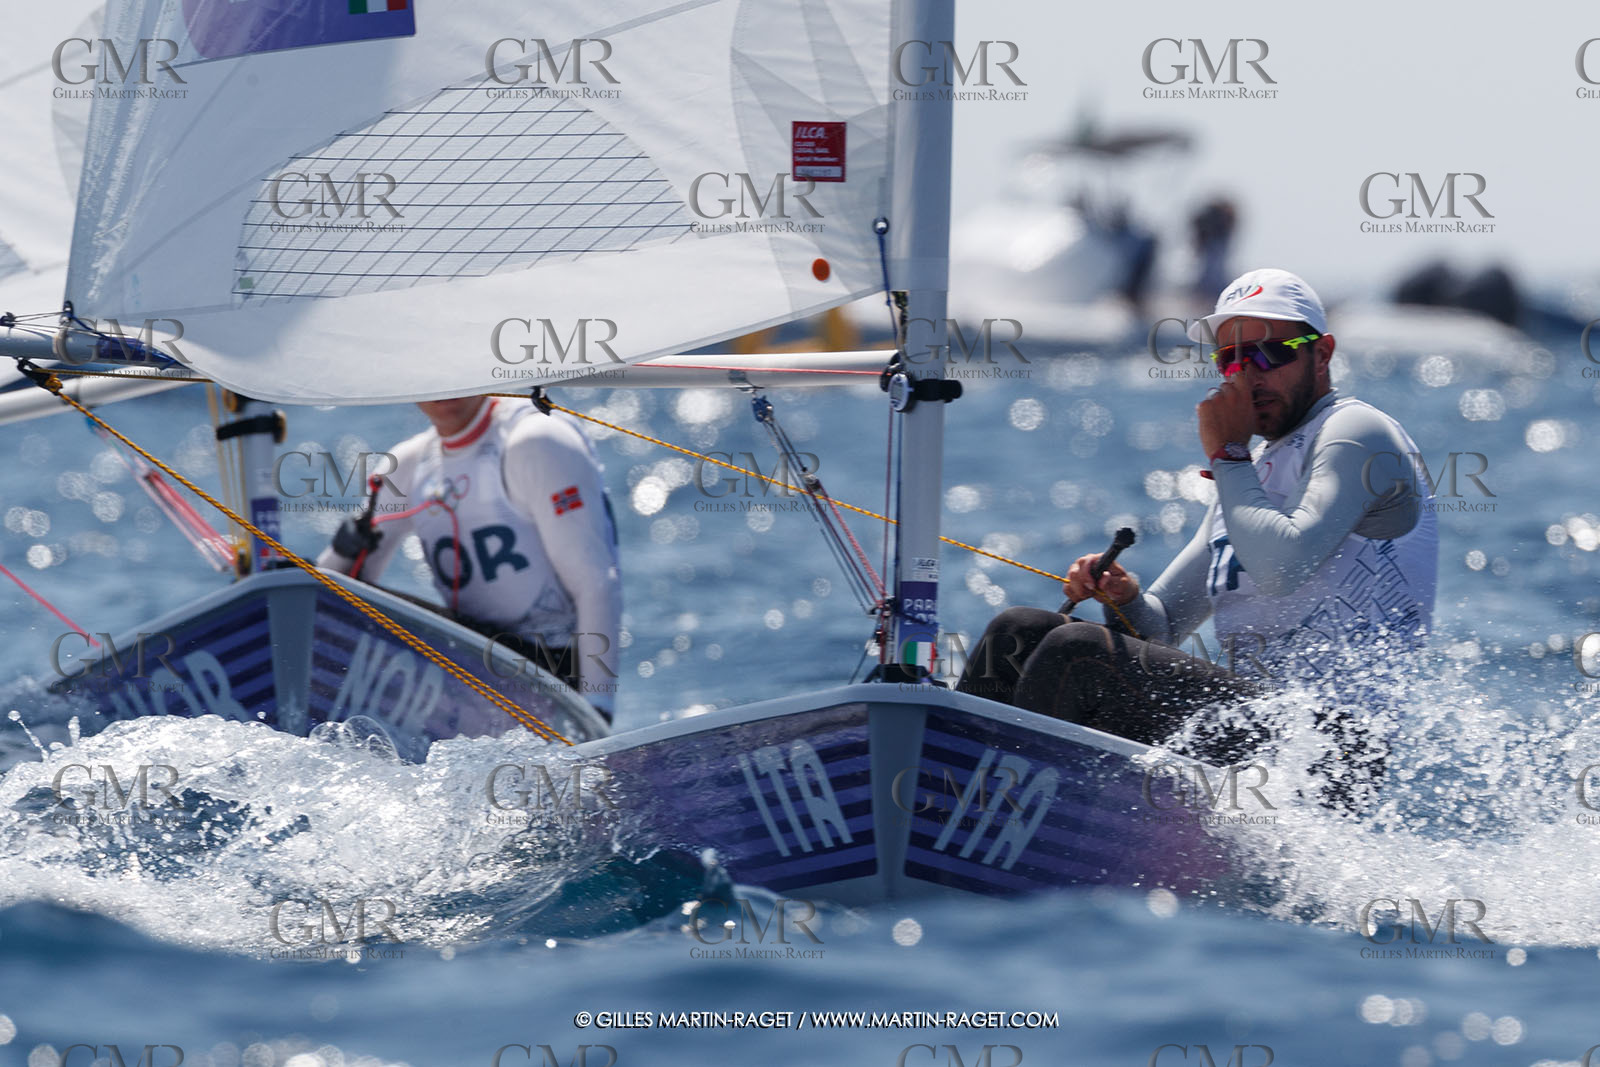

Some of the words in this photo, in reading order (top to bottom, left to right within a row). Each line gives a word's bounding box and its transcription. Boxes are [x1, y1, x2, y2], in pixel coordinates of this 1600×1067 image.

[424, 525, 530, 590] OR
[739, 739, 854, 858] ITA
[932, 748, 1061, 872] ITA
